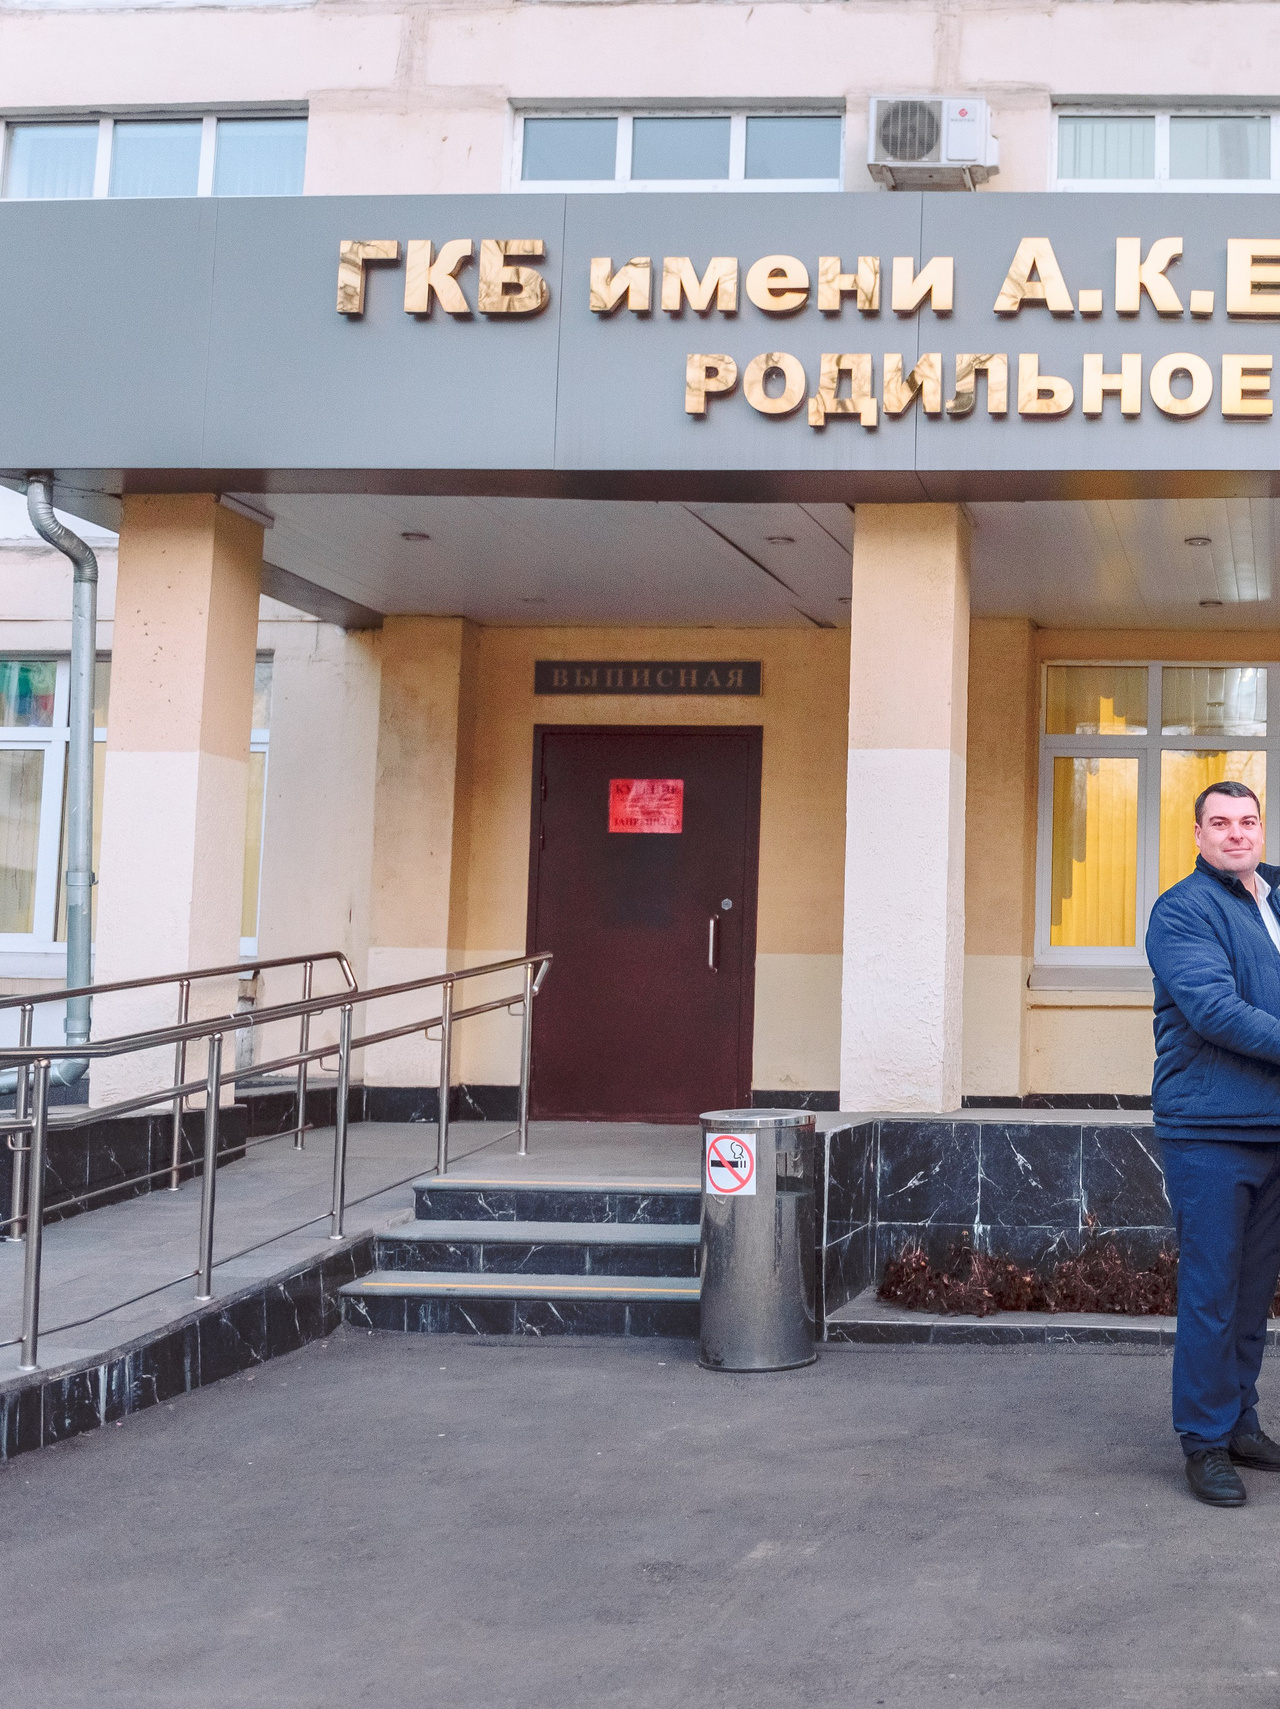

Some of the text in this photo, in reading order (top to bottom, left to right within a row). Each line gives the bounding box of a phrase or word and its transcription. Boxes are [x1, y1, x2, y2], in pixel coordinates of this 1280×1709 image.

[336, 239, 551, 315] ГКБ
[589, 254, 955, 314] имени
[685, 351, 1274, 427] РОДИЛЬНОЕ
[552, 668, 744, 688] ВЫПИСНАЯ
